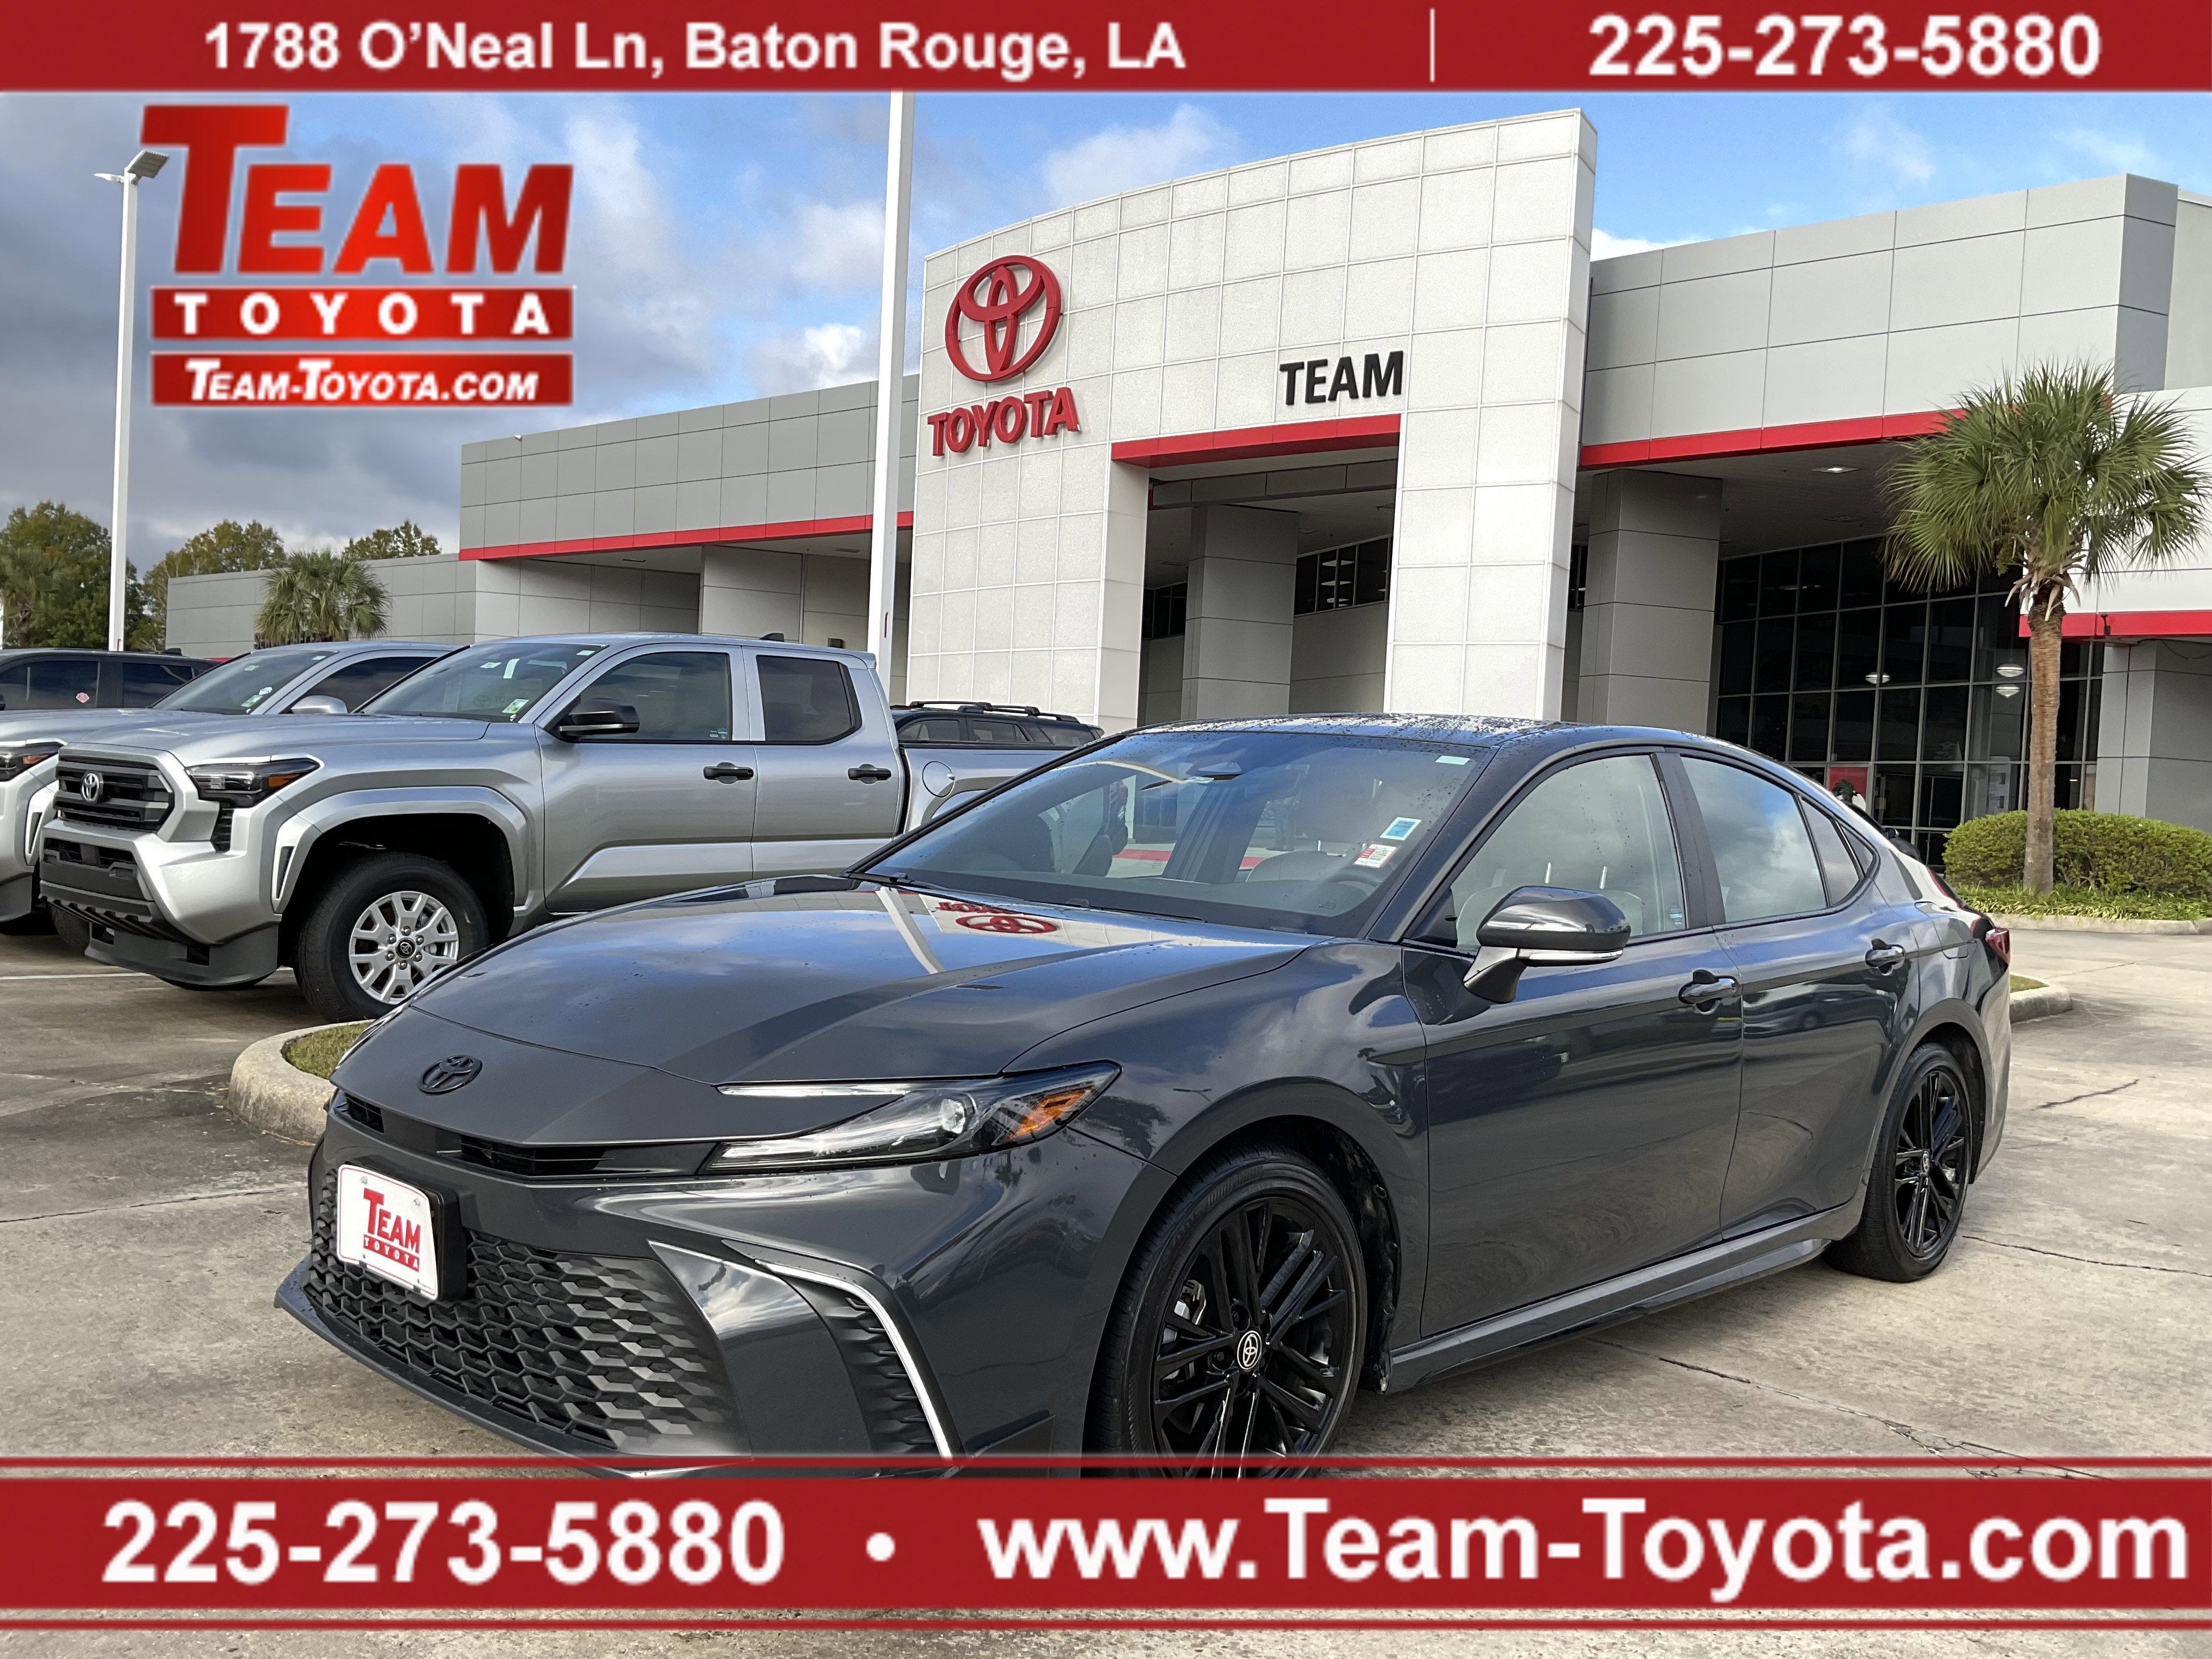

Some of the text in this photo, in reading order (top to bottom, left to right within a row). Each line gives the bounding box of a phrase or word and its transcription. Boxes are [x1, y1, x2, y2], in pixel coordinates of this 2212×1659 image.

[1279, 350, 1404, 406] TEAM
[927, 387, 1080, 457] TOYOTA
[363, 1187, 422, 1254] TEAM
[364, 1236, 419, 1269] TOYOTA
